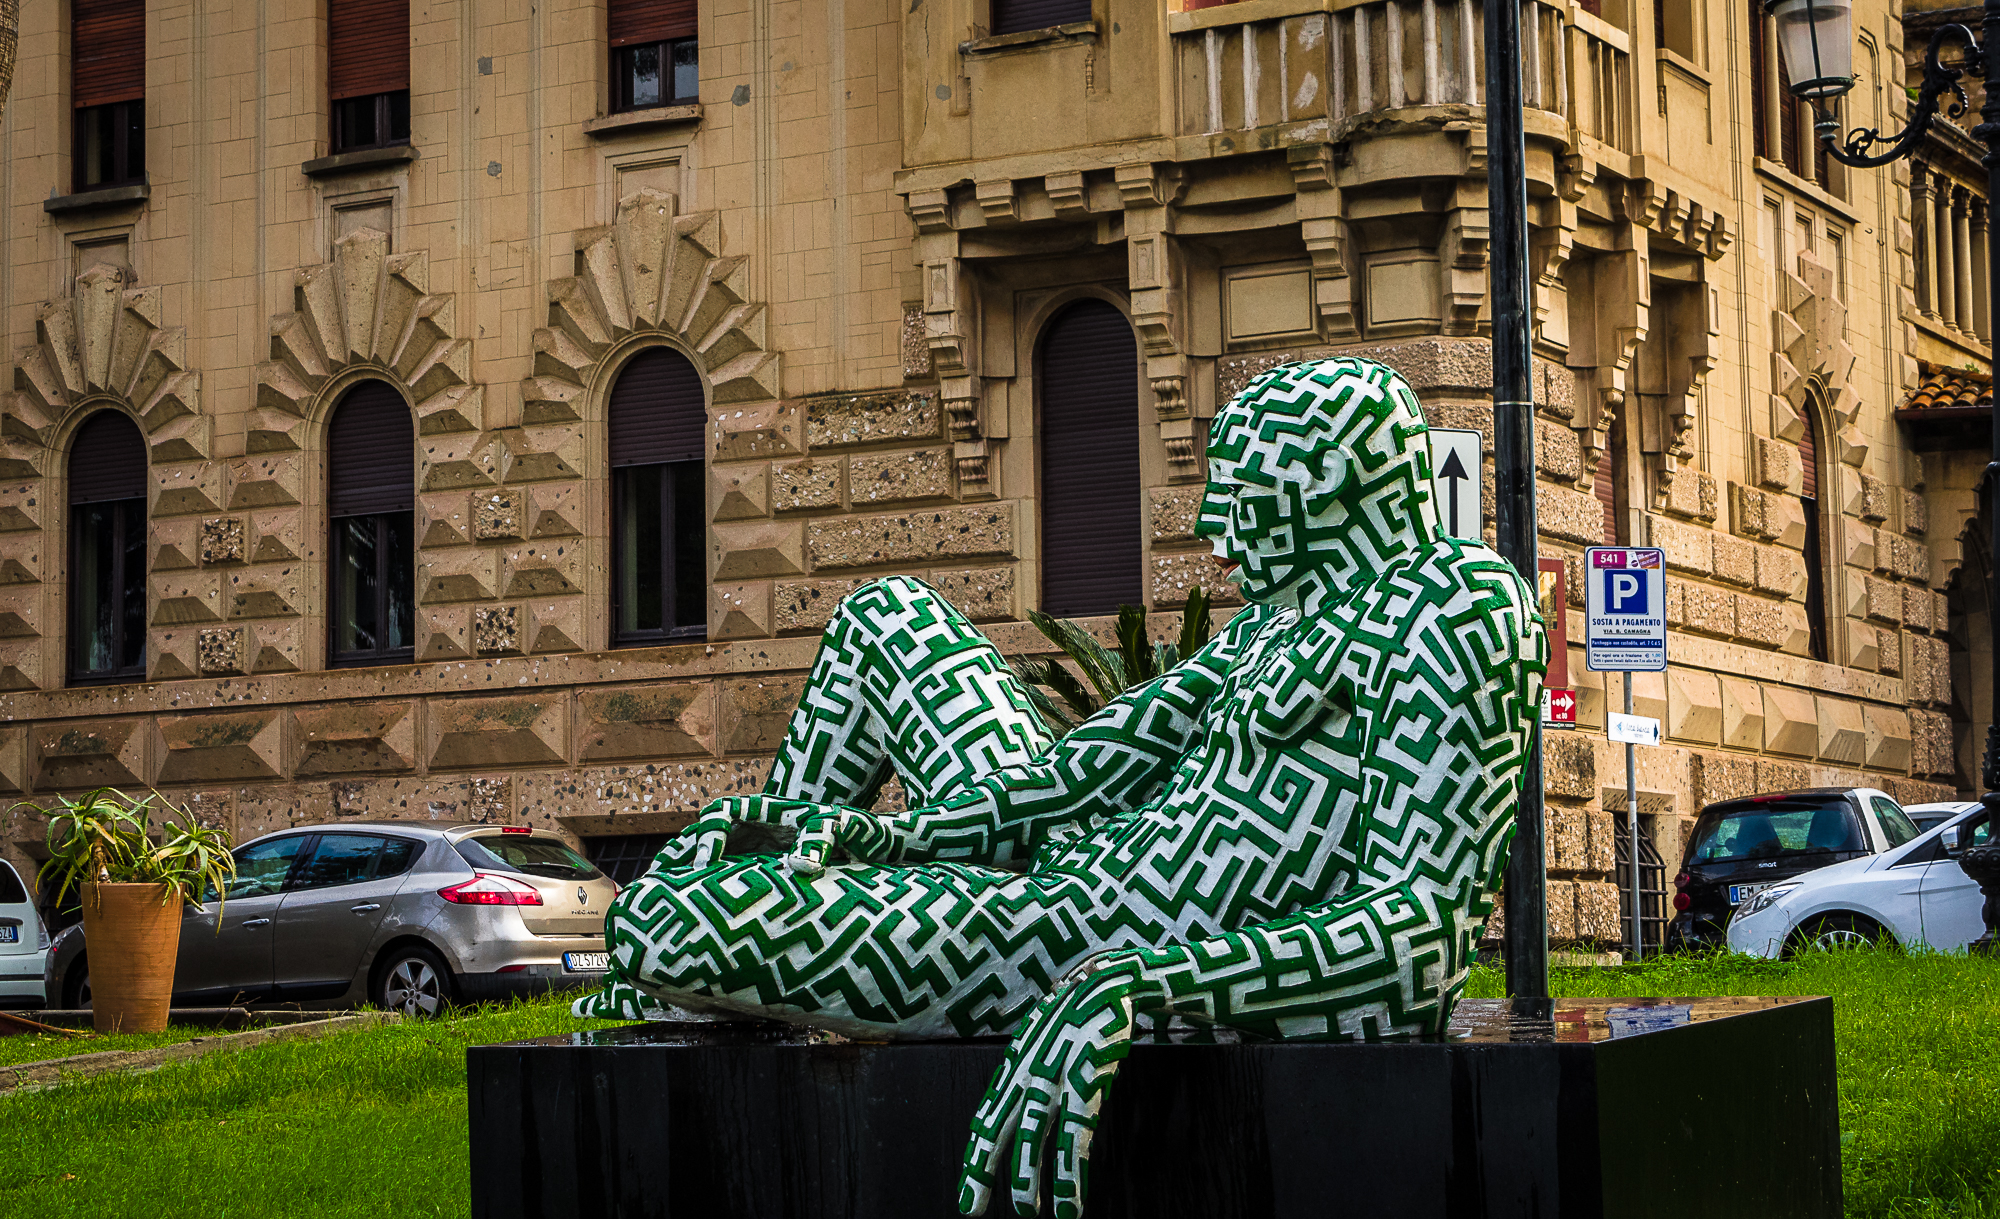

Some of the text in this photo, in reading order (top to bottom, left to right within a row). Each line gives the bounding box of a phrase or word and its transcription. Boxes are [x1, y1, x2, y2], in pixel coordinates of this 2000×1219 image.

[1600, 554, 1618, 563] 541
[1613, 574, 1639, 609] P
[1592, 618, 1661, 626] SOSTA A PAGAMENTO
[1739, 886, 1754, 899] EM
[571, 953, 583, 966] DZ
